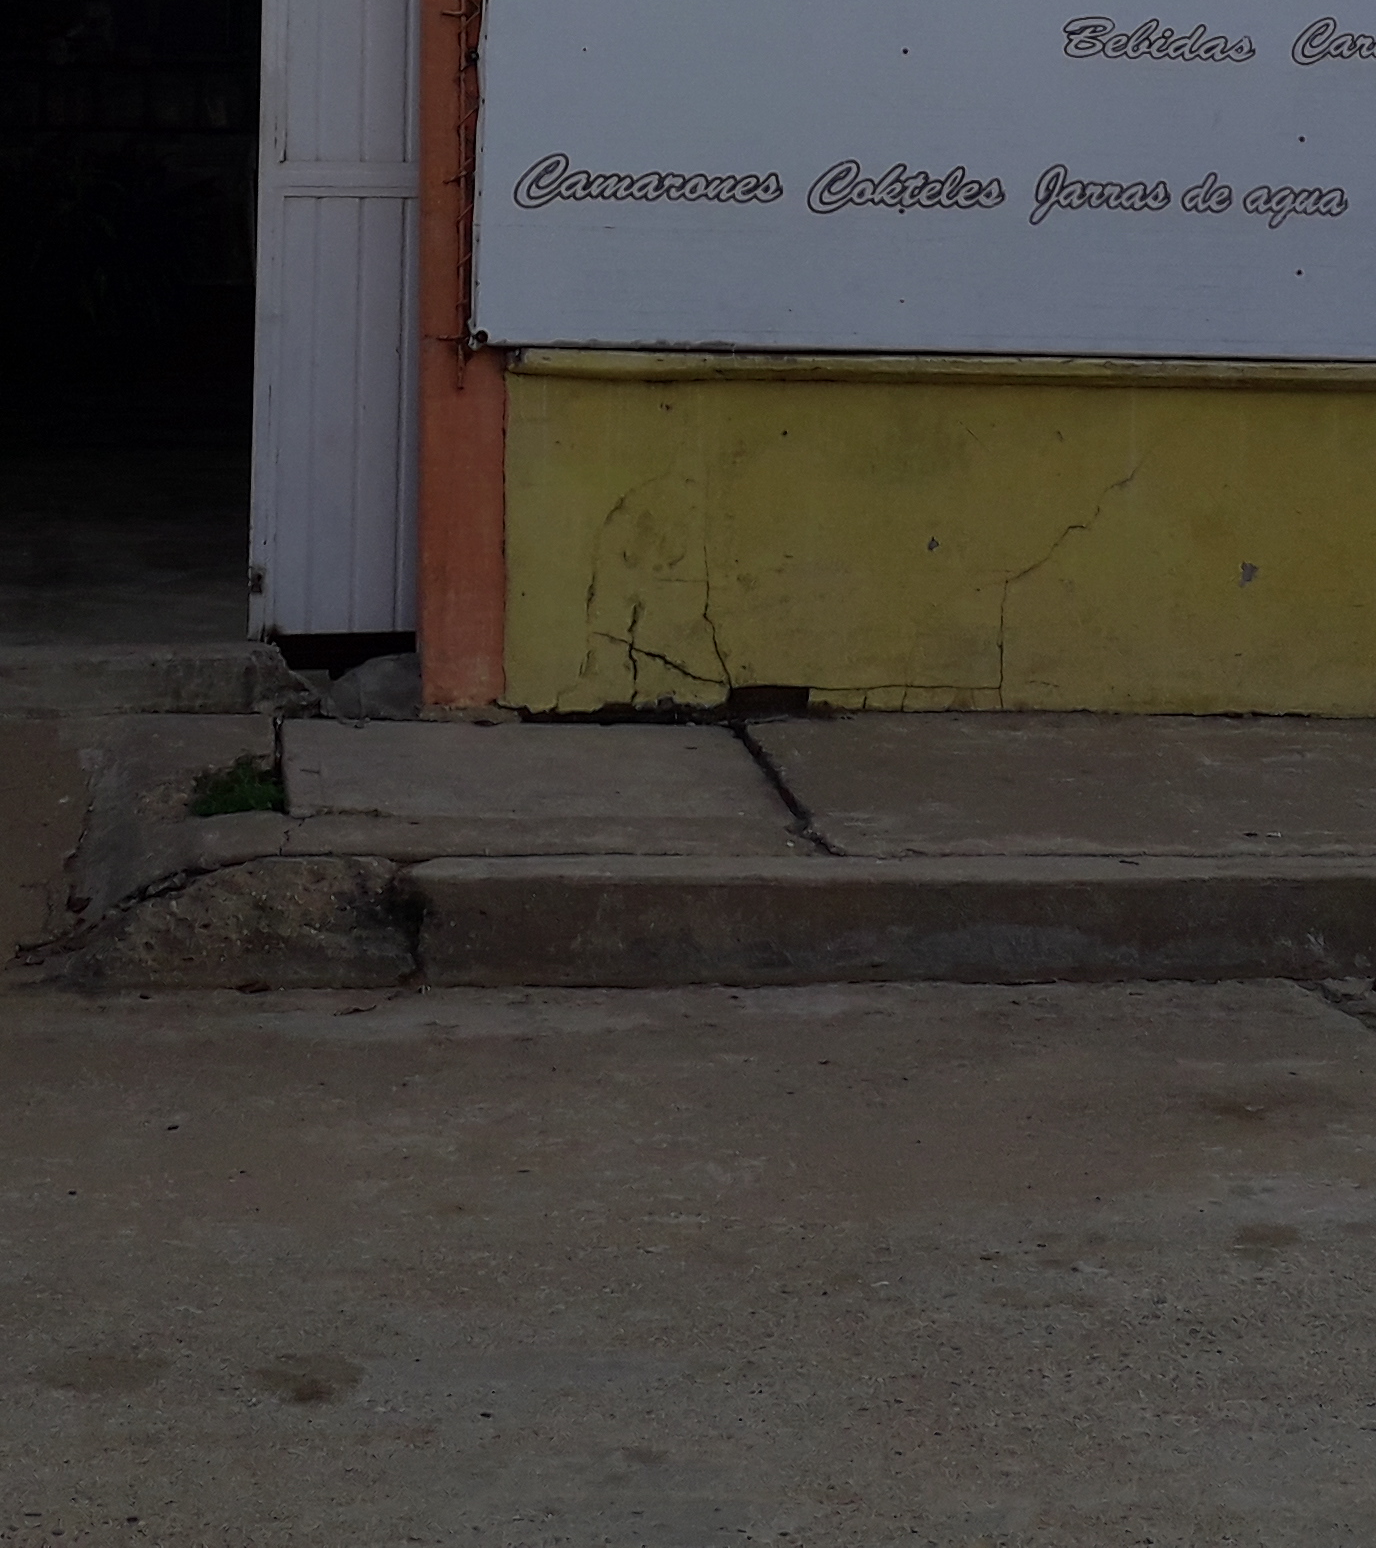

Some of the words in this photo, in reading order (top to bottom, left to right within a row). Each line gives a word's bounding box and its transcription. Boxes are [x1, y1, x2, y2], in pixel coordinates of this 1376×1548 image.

[1062, 16, 1256, 62] Bebidas
[513, 152, 784, 209] Camarones
[806, 159, 1005, 214] Cokteles
[1028, 163, 1172, 226] Jarras
[1180, 171, 1234, 214] de
[1242, 185, 1349, 229] agua
